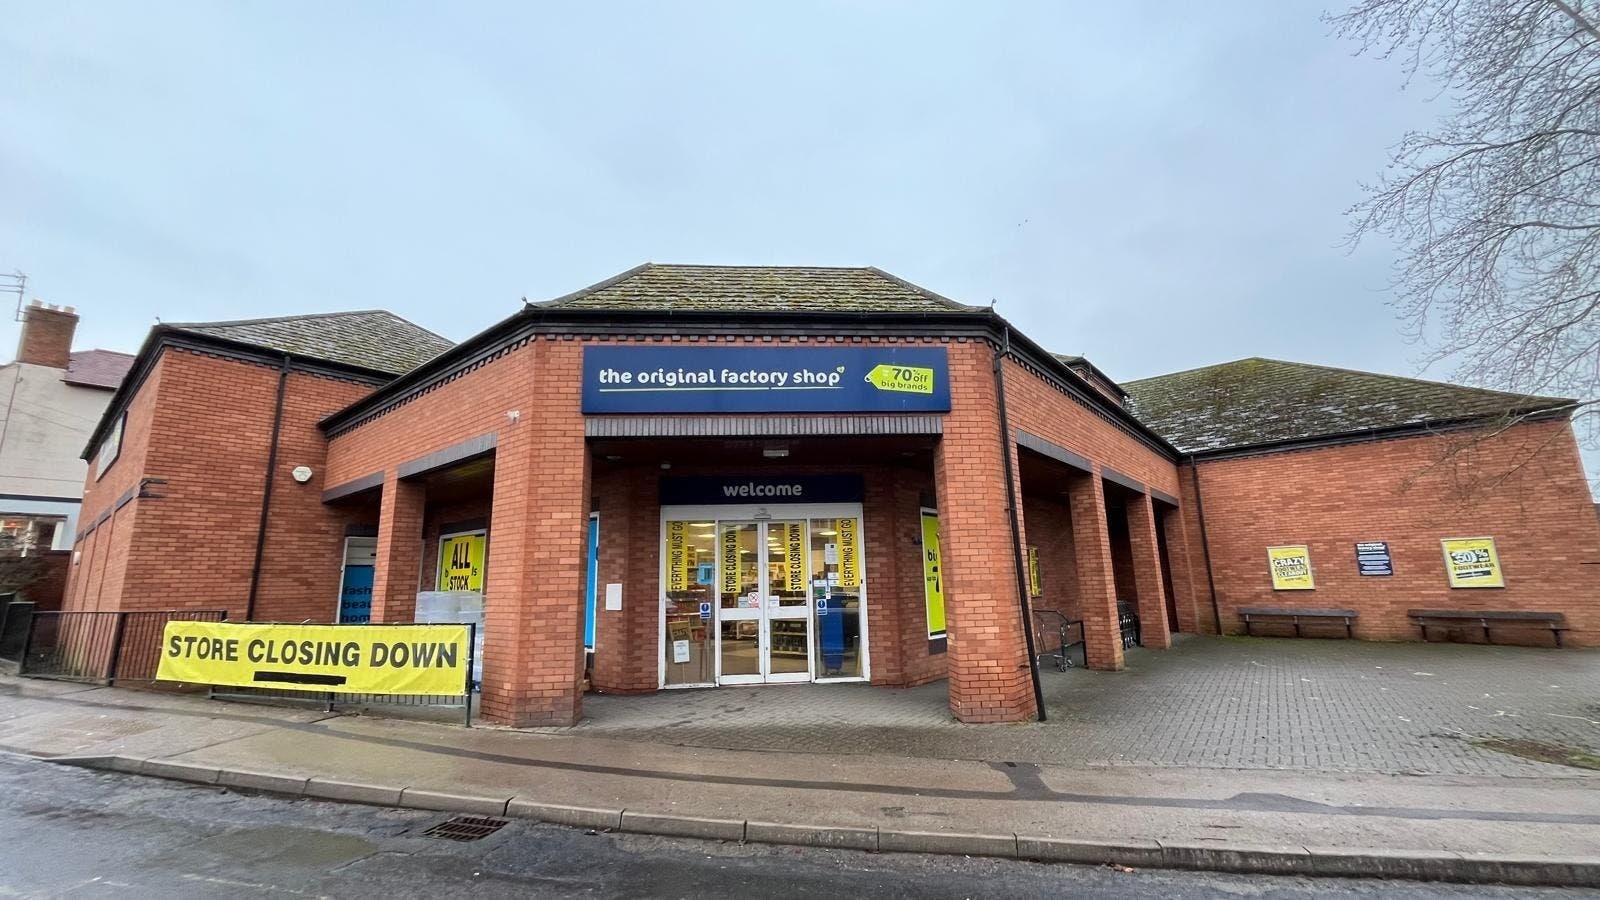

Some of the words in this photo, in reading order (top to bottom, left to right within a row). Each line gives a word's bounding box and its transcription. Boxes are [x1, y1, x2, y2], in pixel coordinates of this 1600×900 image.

[599, 368, 632, 384] the
[638, 368, 716, 387] original
[721, 368, 788, 387] factory
[793, 368, 841, 387] shop
[881, 380, 896, 389] big
[897, 381, 928, 391] brands
[913, 374, 928, 383] off
[723, 482, 803, 497] welcome
[672, 521, 684, 531] GO
[840, 519, 852, 528] GO
[671, 532, 683, 550] MUST
[788, 524, 801, 542] DOWN
[841, 530, 853, 546] MUST
[450, 541, 471, 570] ALL
[725, 544, 737, 571] CLOSING
[789, 543, 802, 569] CLOSING
[1274, 557, 1304, 567] CRAZY
[671, 550, 683, 590] EVERYTHING
[842, 546, 855, 587] EVERYTHING
[449, 575, 470, 591] STOCK
[725, 571, 737, 592] STORE
[790, 570, 802, 591] STORE
[344, 585, 372, 596] fash
[168, 635, 239, 662] STORE
[249, 638, 361, 668] CLOSING
[369, 642, 458, 668] DOWN
